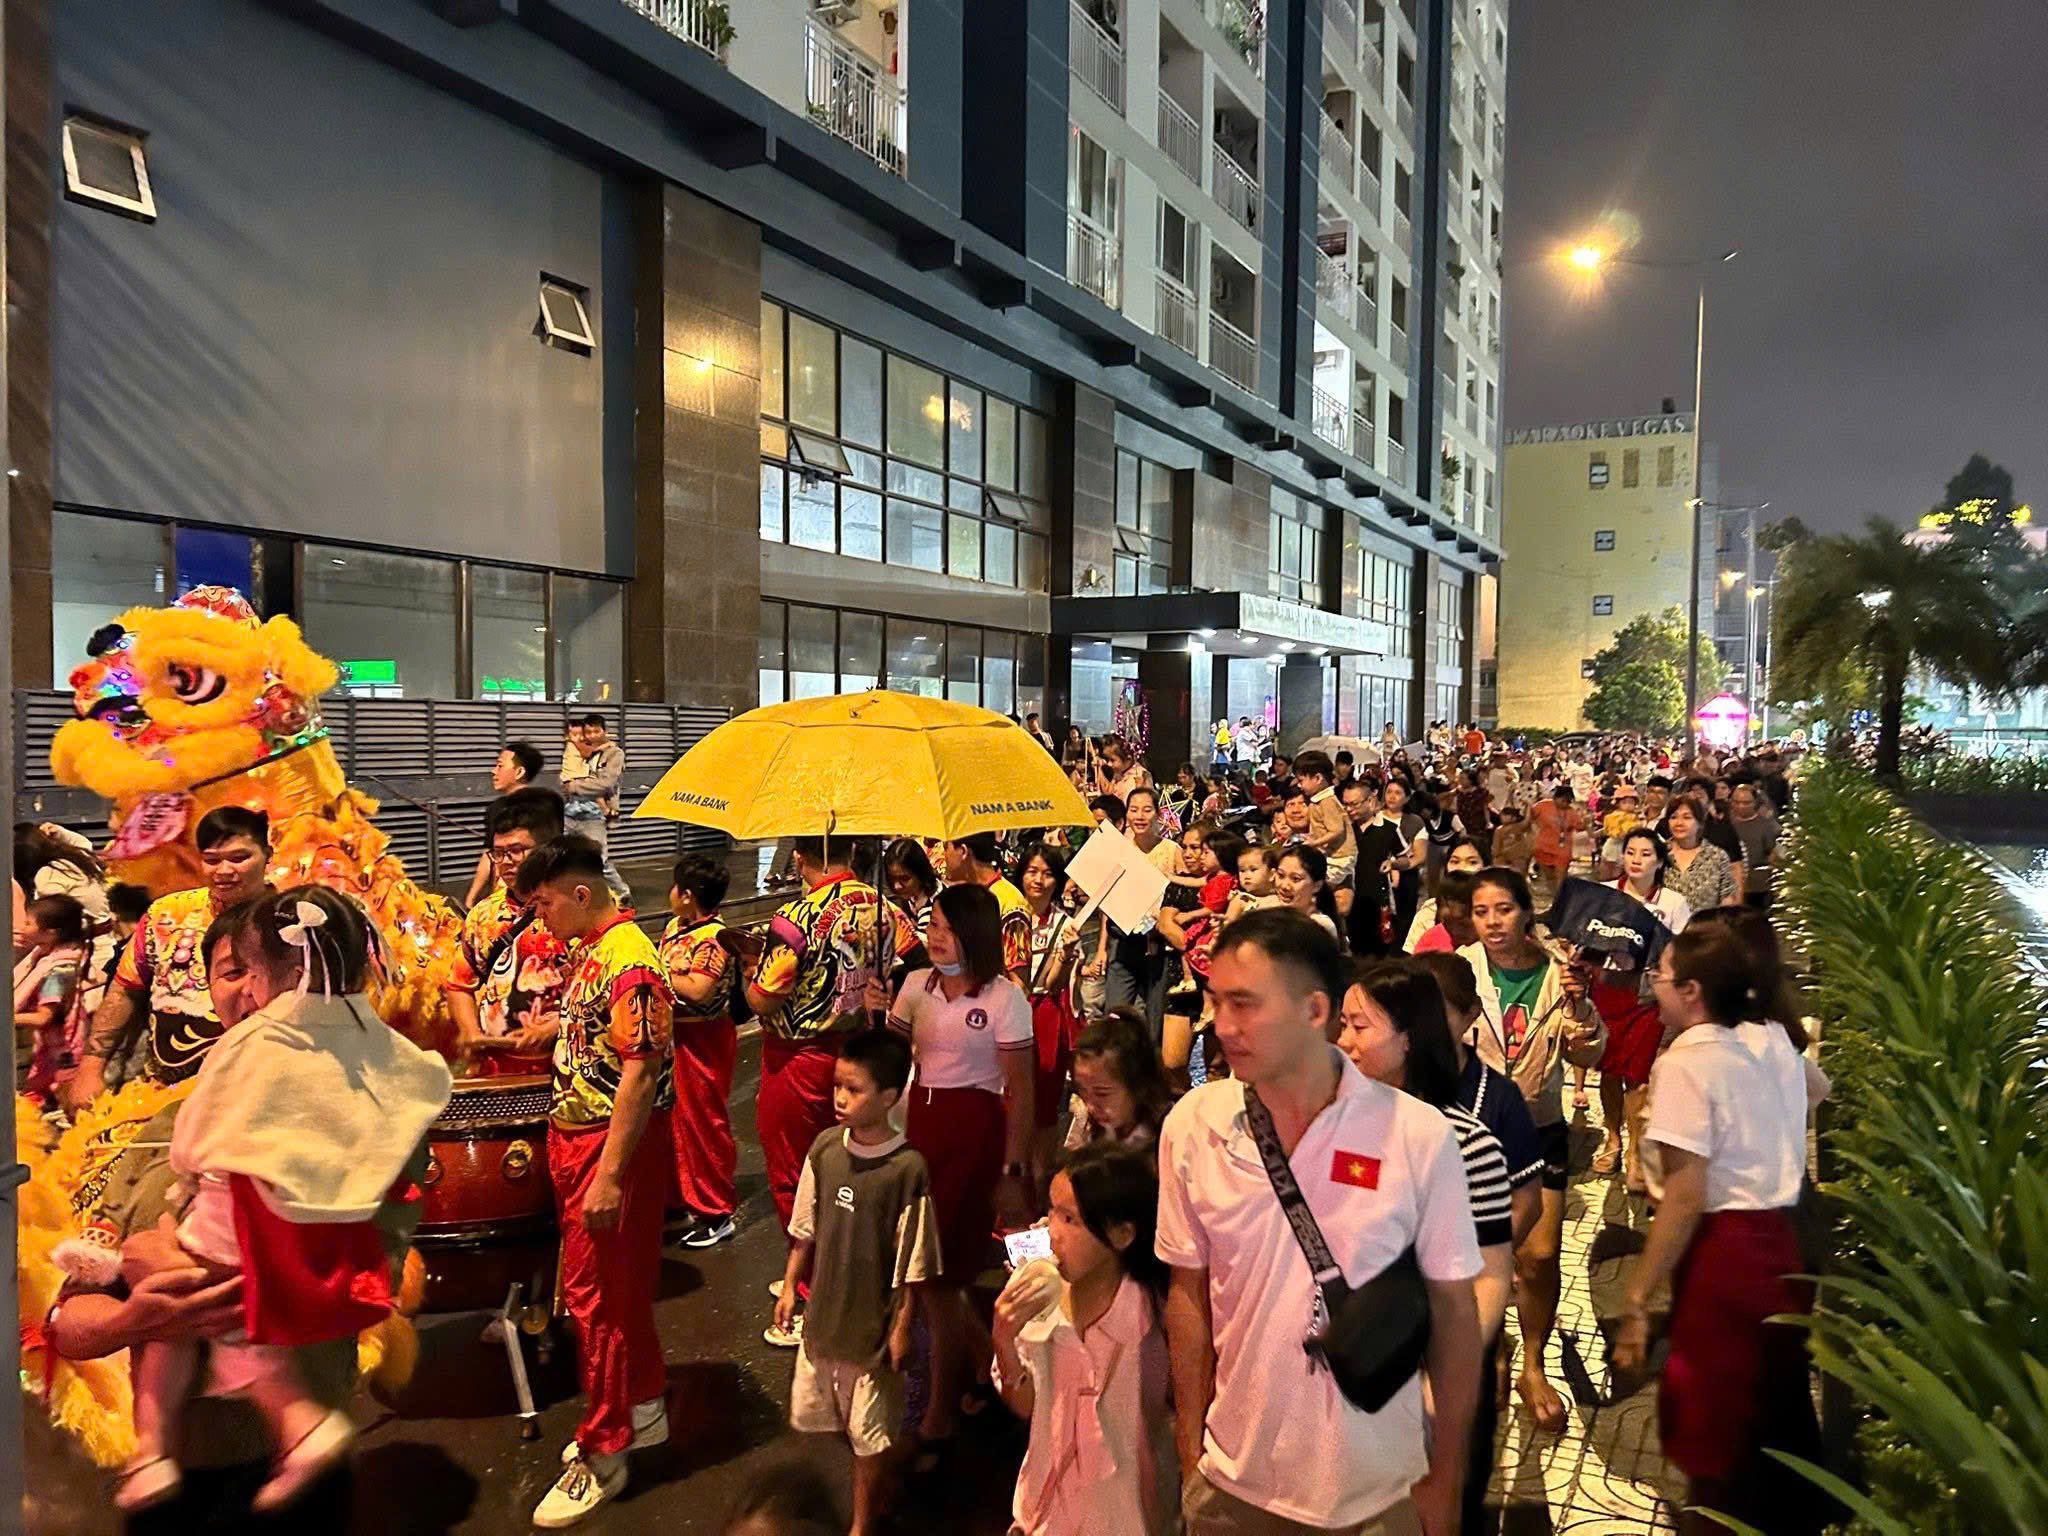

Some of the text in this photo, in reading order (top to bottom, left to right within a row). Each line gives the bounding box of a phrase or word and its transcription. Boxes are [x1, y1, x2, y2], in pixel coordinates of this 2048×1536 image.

[1511, 416, 1686, 445] KARAOKE VEGAS
[670, 791, 730, 811] NAM A BANK
[970, 799, 1056, 816] NAM A BANK
